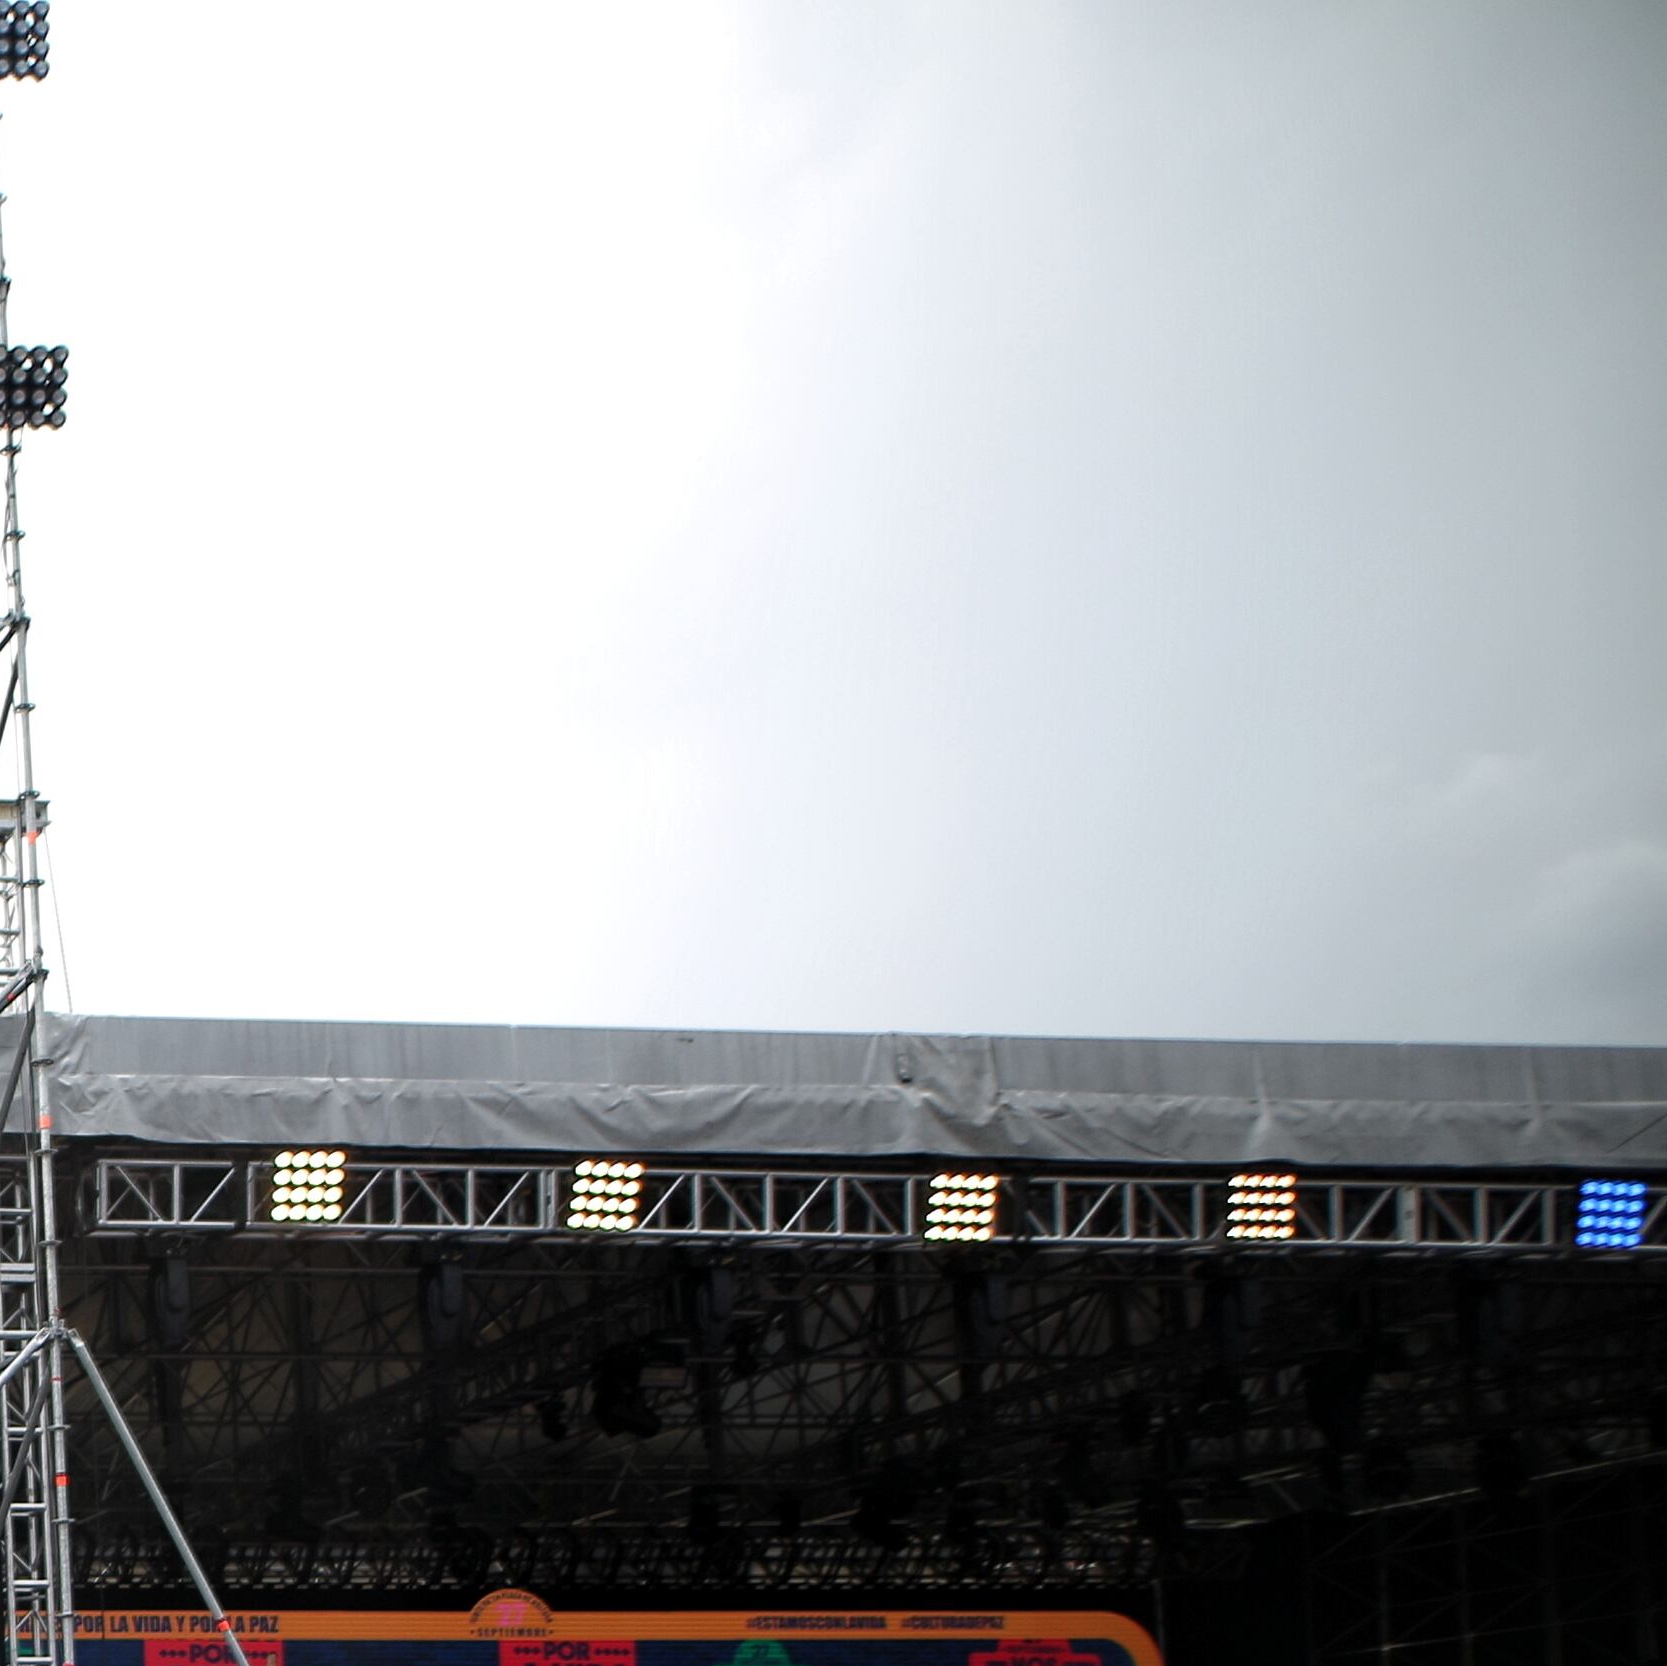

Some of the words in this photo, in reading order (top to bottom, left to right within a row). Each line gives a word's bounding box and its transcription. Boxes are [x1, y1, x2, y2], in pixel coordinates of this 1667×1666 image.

[74, 1616, 104, 1633] POR
[110, 1616, 129, 1633] LA
[138, 1615, 171, 1633] VIDA
[176, 1615, 185, 1633] Y
[249, 1616, 279, 1633] PAZ
[543, 1641, 590, 1661] POR
